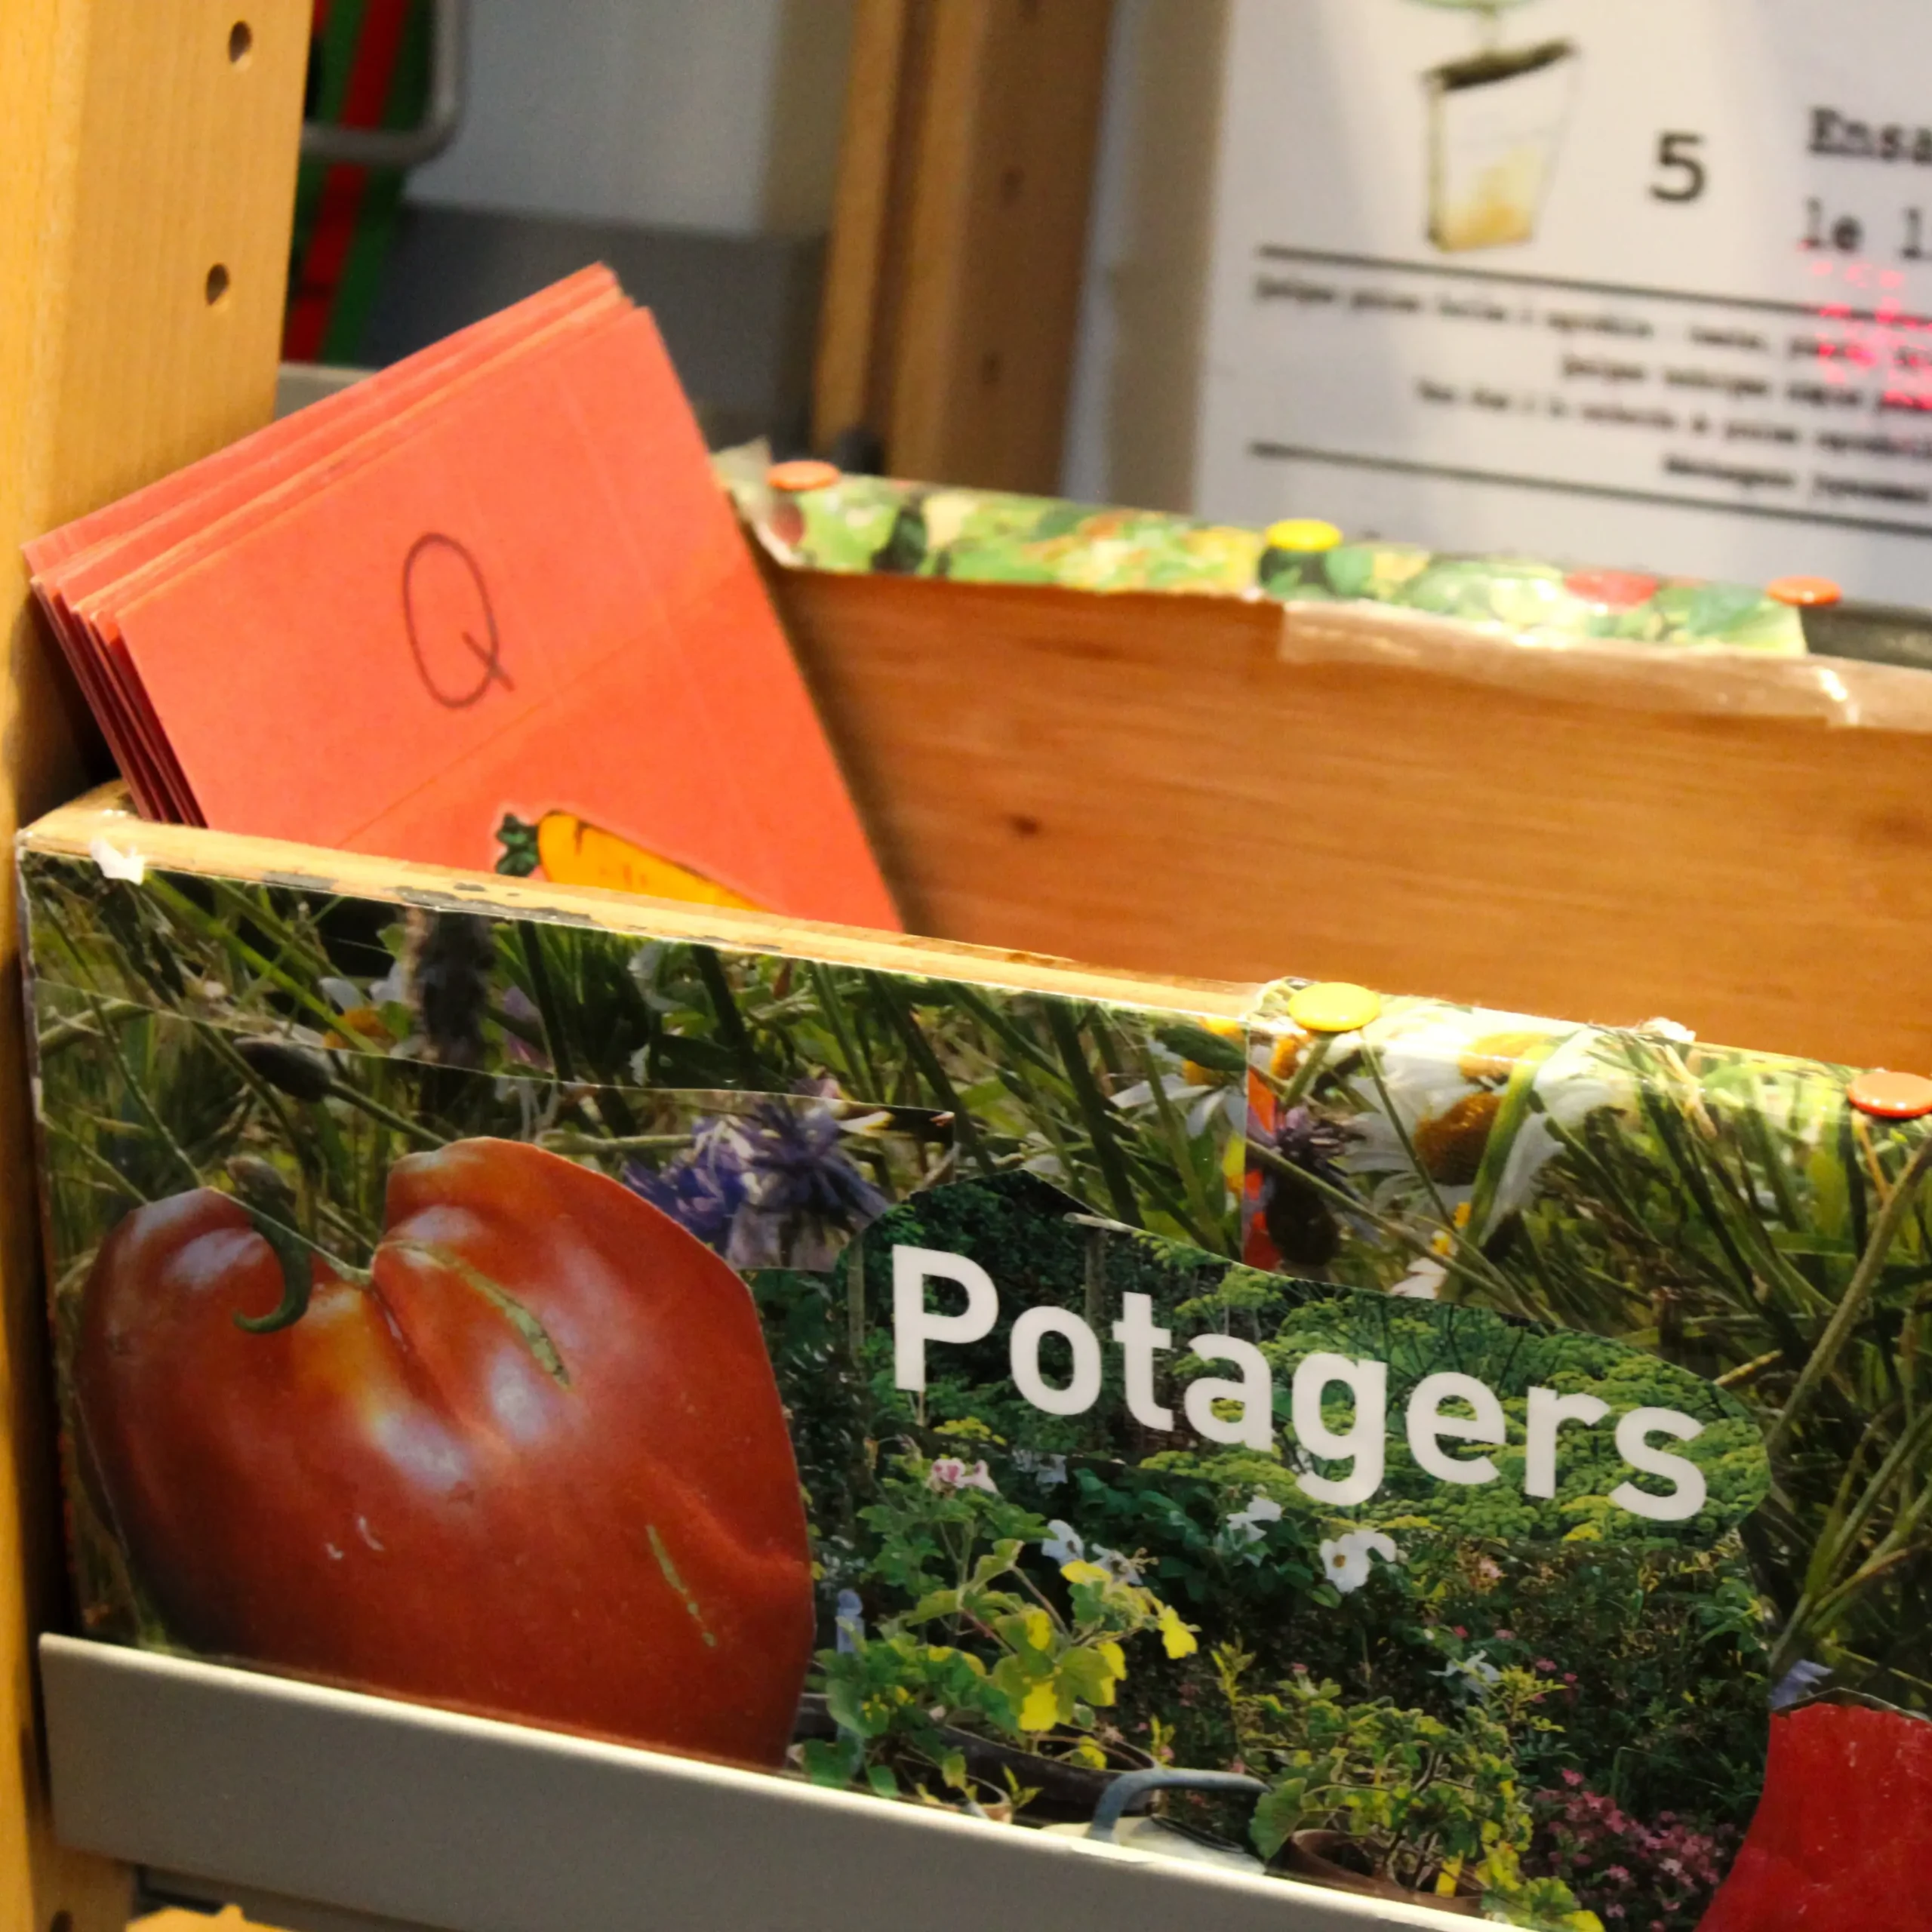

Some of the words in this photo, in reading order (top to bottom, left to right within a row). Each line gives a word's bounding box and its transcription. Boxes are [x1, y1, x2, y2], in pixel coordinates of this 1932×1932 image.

[1651, 131, 1705, 202] 5
[1804, 197, 1863, 253] le
[402, 533, 515, 709] Q
[893, 1244, 1707, 1521] Potagers
